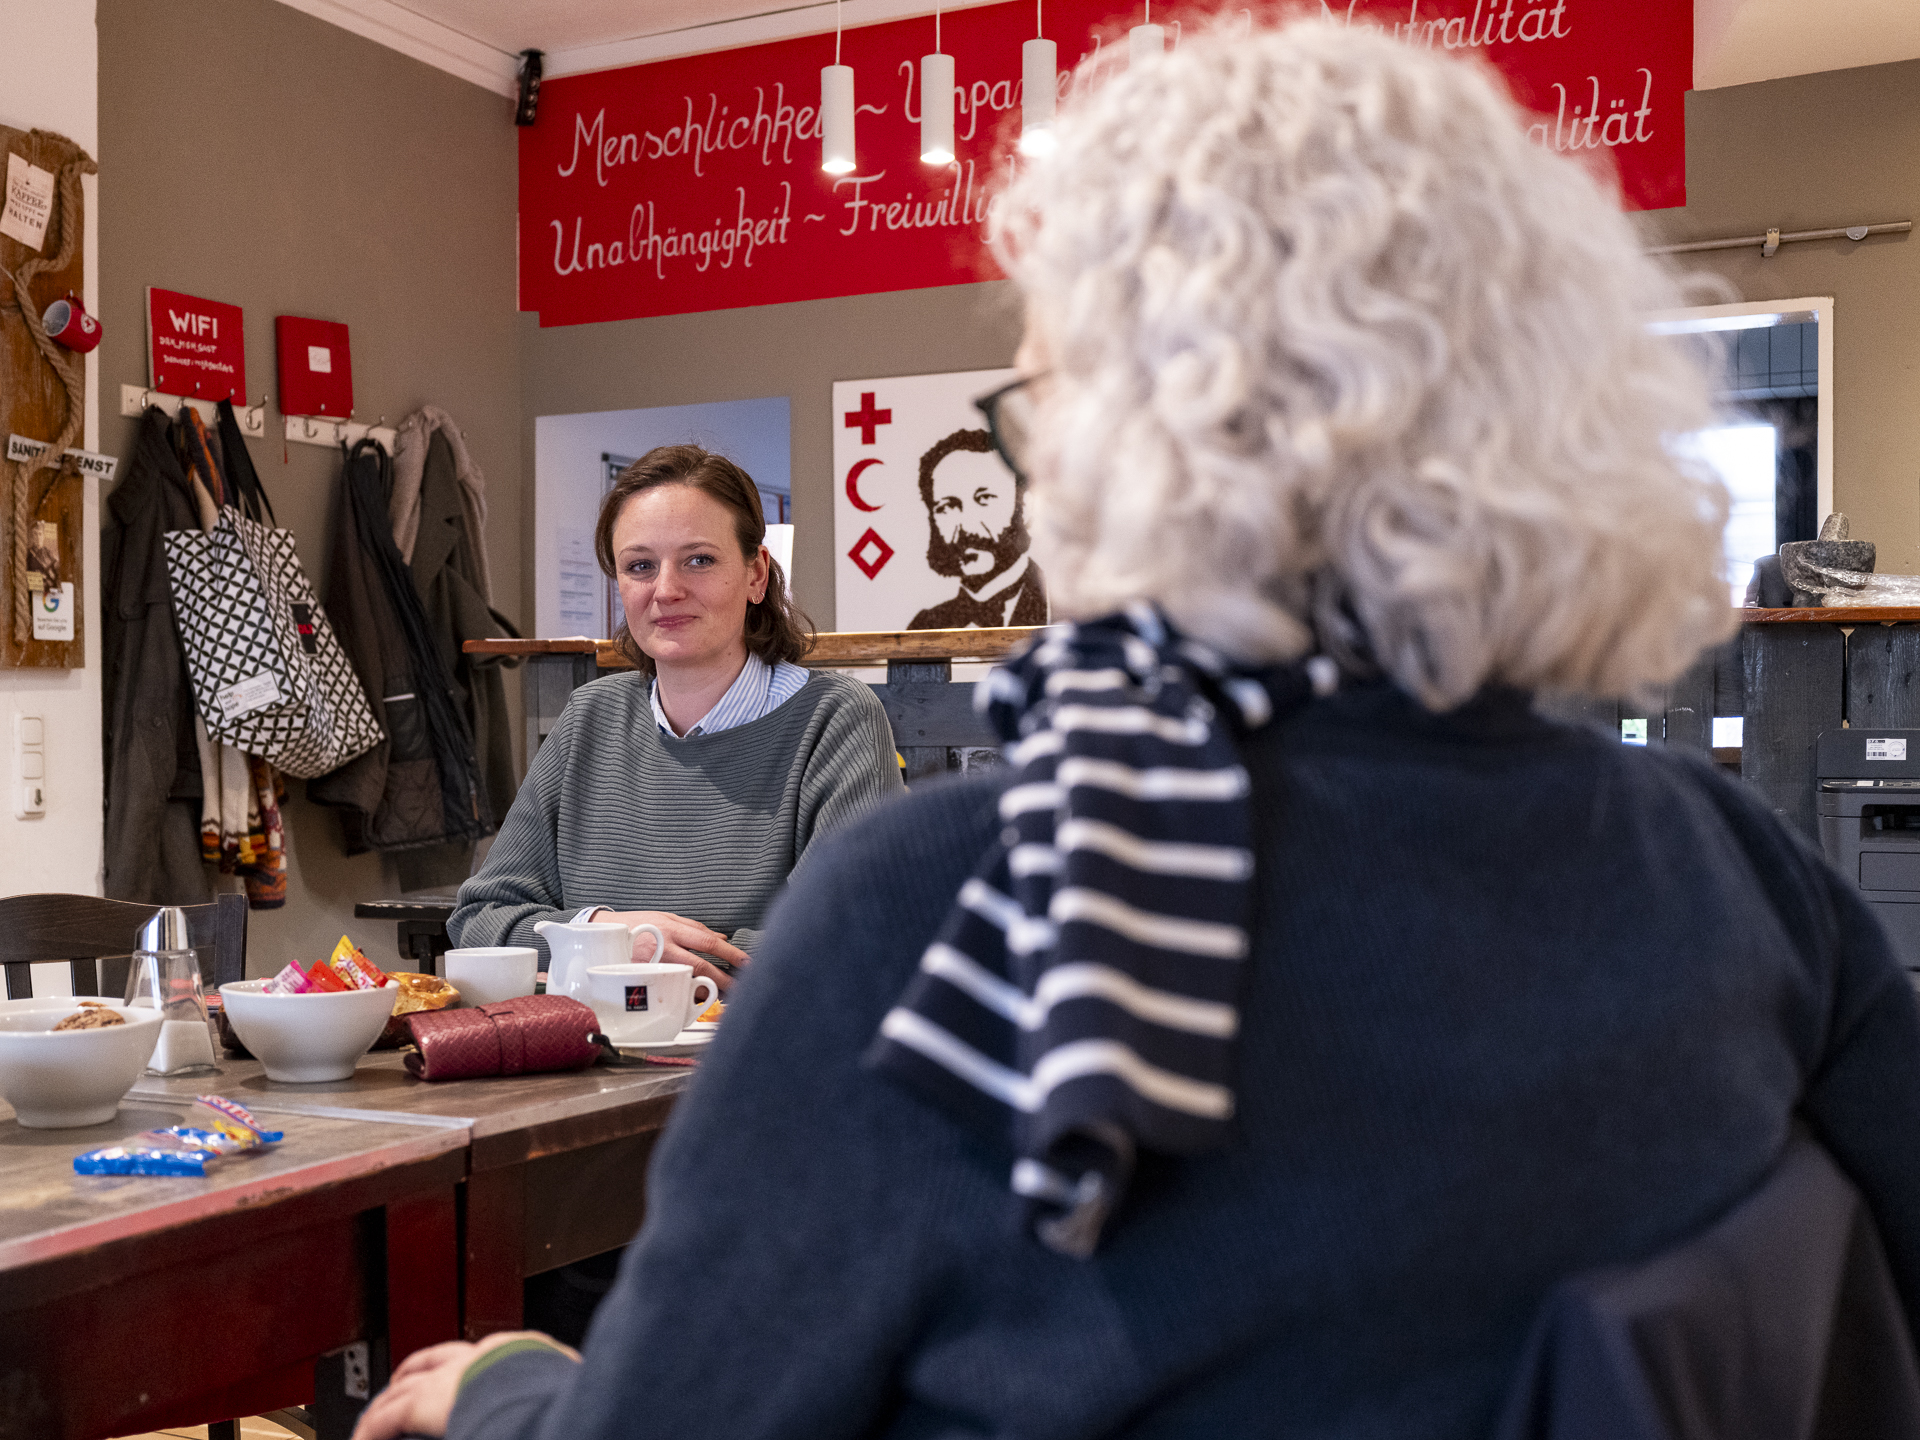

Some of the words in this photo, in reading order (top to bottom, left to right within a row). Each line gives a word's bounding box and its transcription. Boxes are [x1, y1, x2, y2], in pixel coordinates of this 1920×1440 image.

[557, 82, 823, 187] Menschlichke
[1320, 0, 1573, 49] tralität
[8, 206, 43, 230] HALTEN
[549, 181, 791, 279] Unabhängigkeit
[833, 157, 1015, 244] Freiwilli
[168, 308, 218, 339] WIFI
